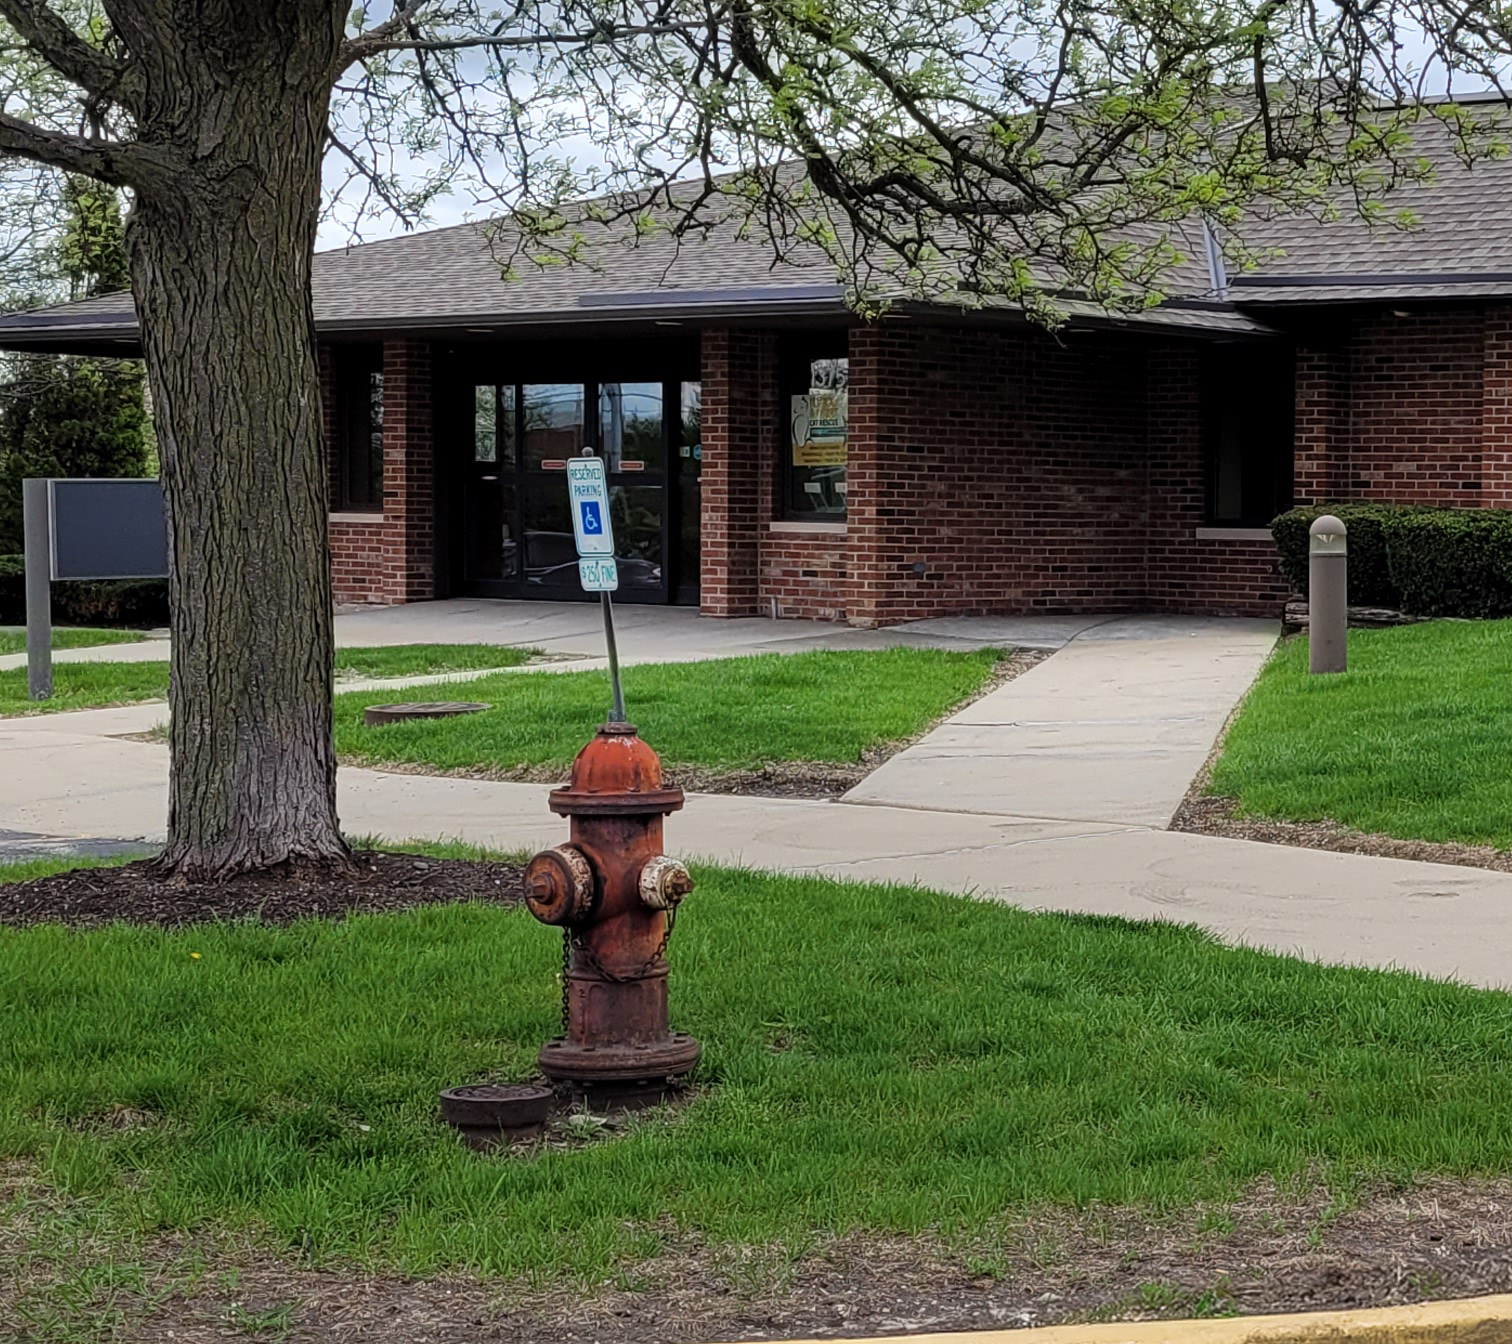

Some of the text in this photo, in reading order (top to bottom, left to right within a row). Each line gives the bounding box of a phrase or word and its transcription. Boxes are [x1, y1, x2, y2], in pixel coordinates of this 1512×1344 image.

[570, 467, 601, 480] RESERVED
[573, 484, 602, 497] PARKING
[601, 565, 616, 583] FINE
